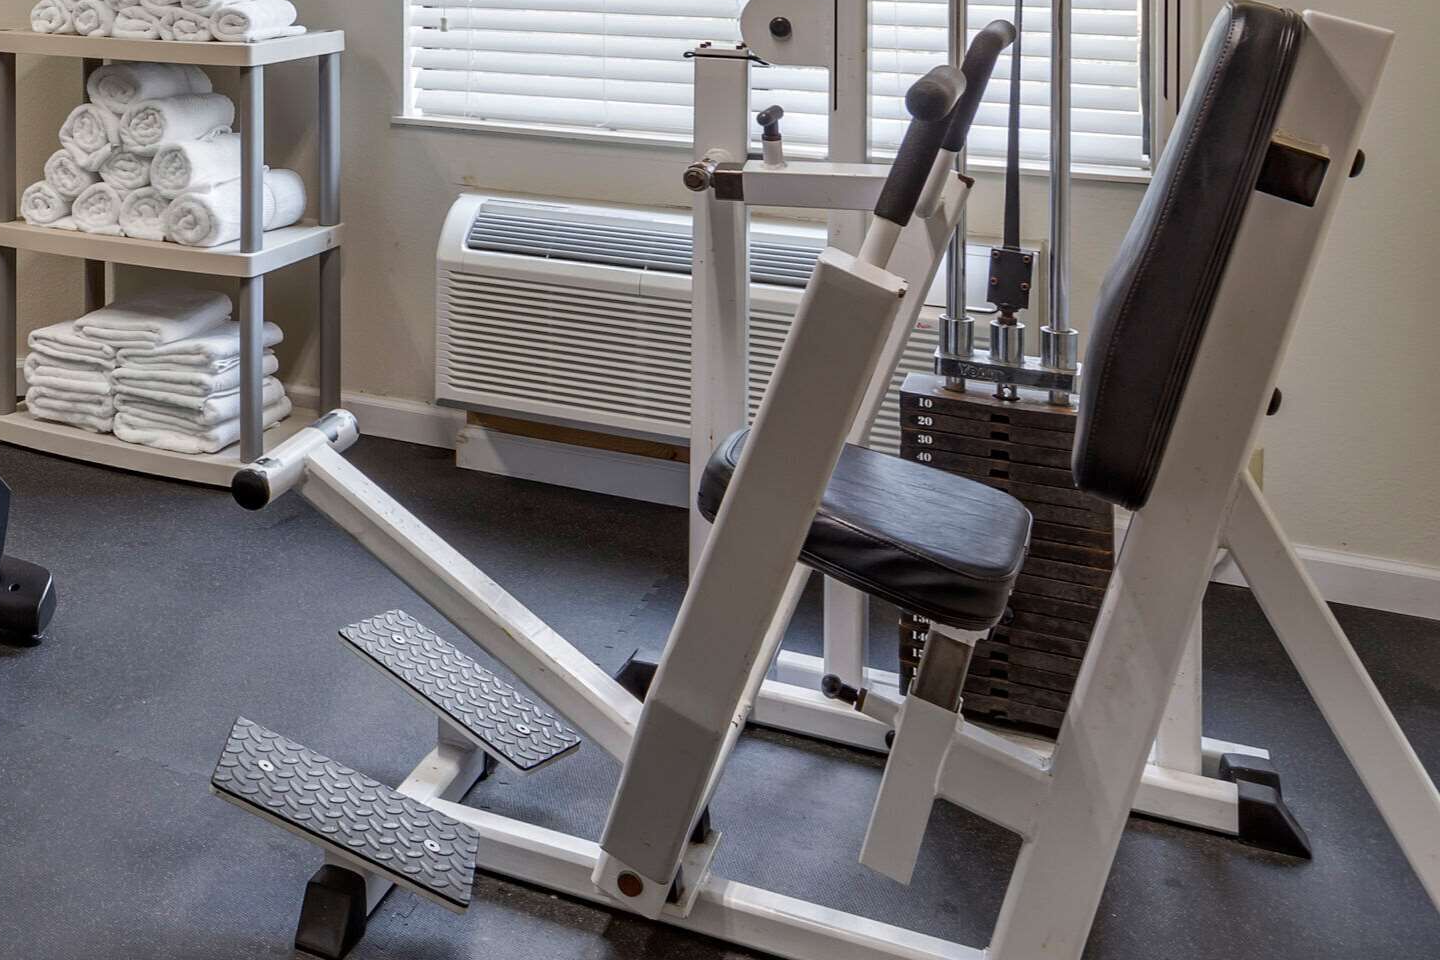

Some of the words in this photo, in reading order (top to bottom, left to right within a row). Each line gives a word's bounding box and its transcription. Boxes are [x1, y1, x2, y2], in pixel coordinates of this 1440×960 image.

[918, 397, 933, 408] 10
[917, 416, 933, 426] 20
[917, 434, 933, 444] 30
[916, 452, 932, 462] 40
